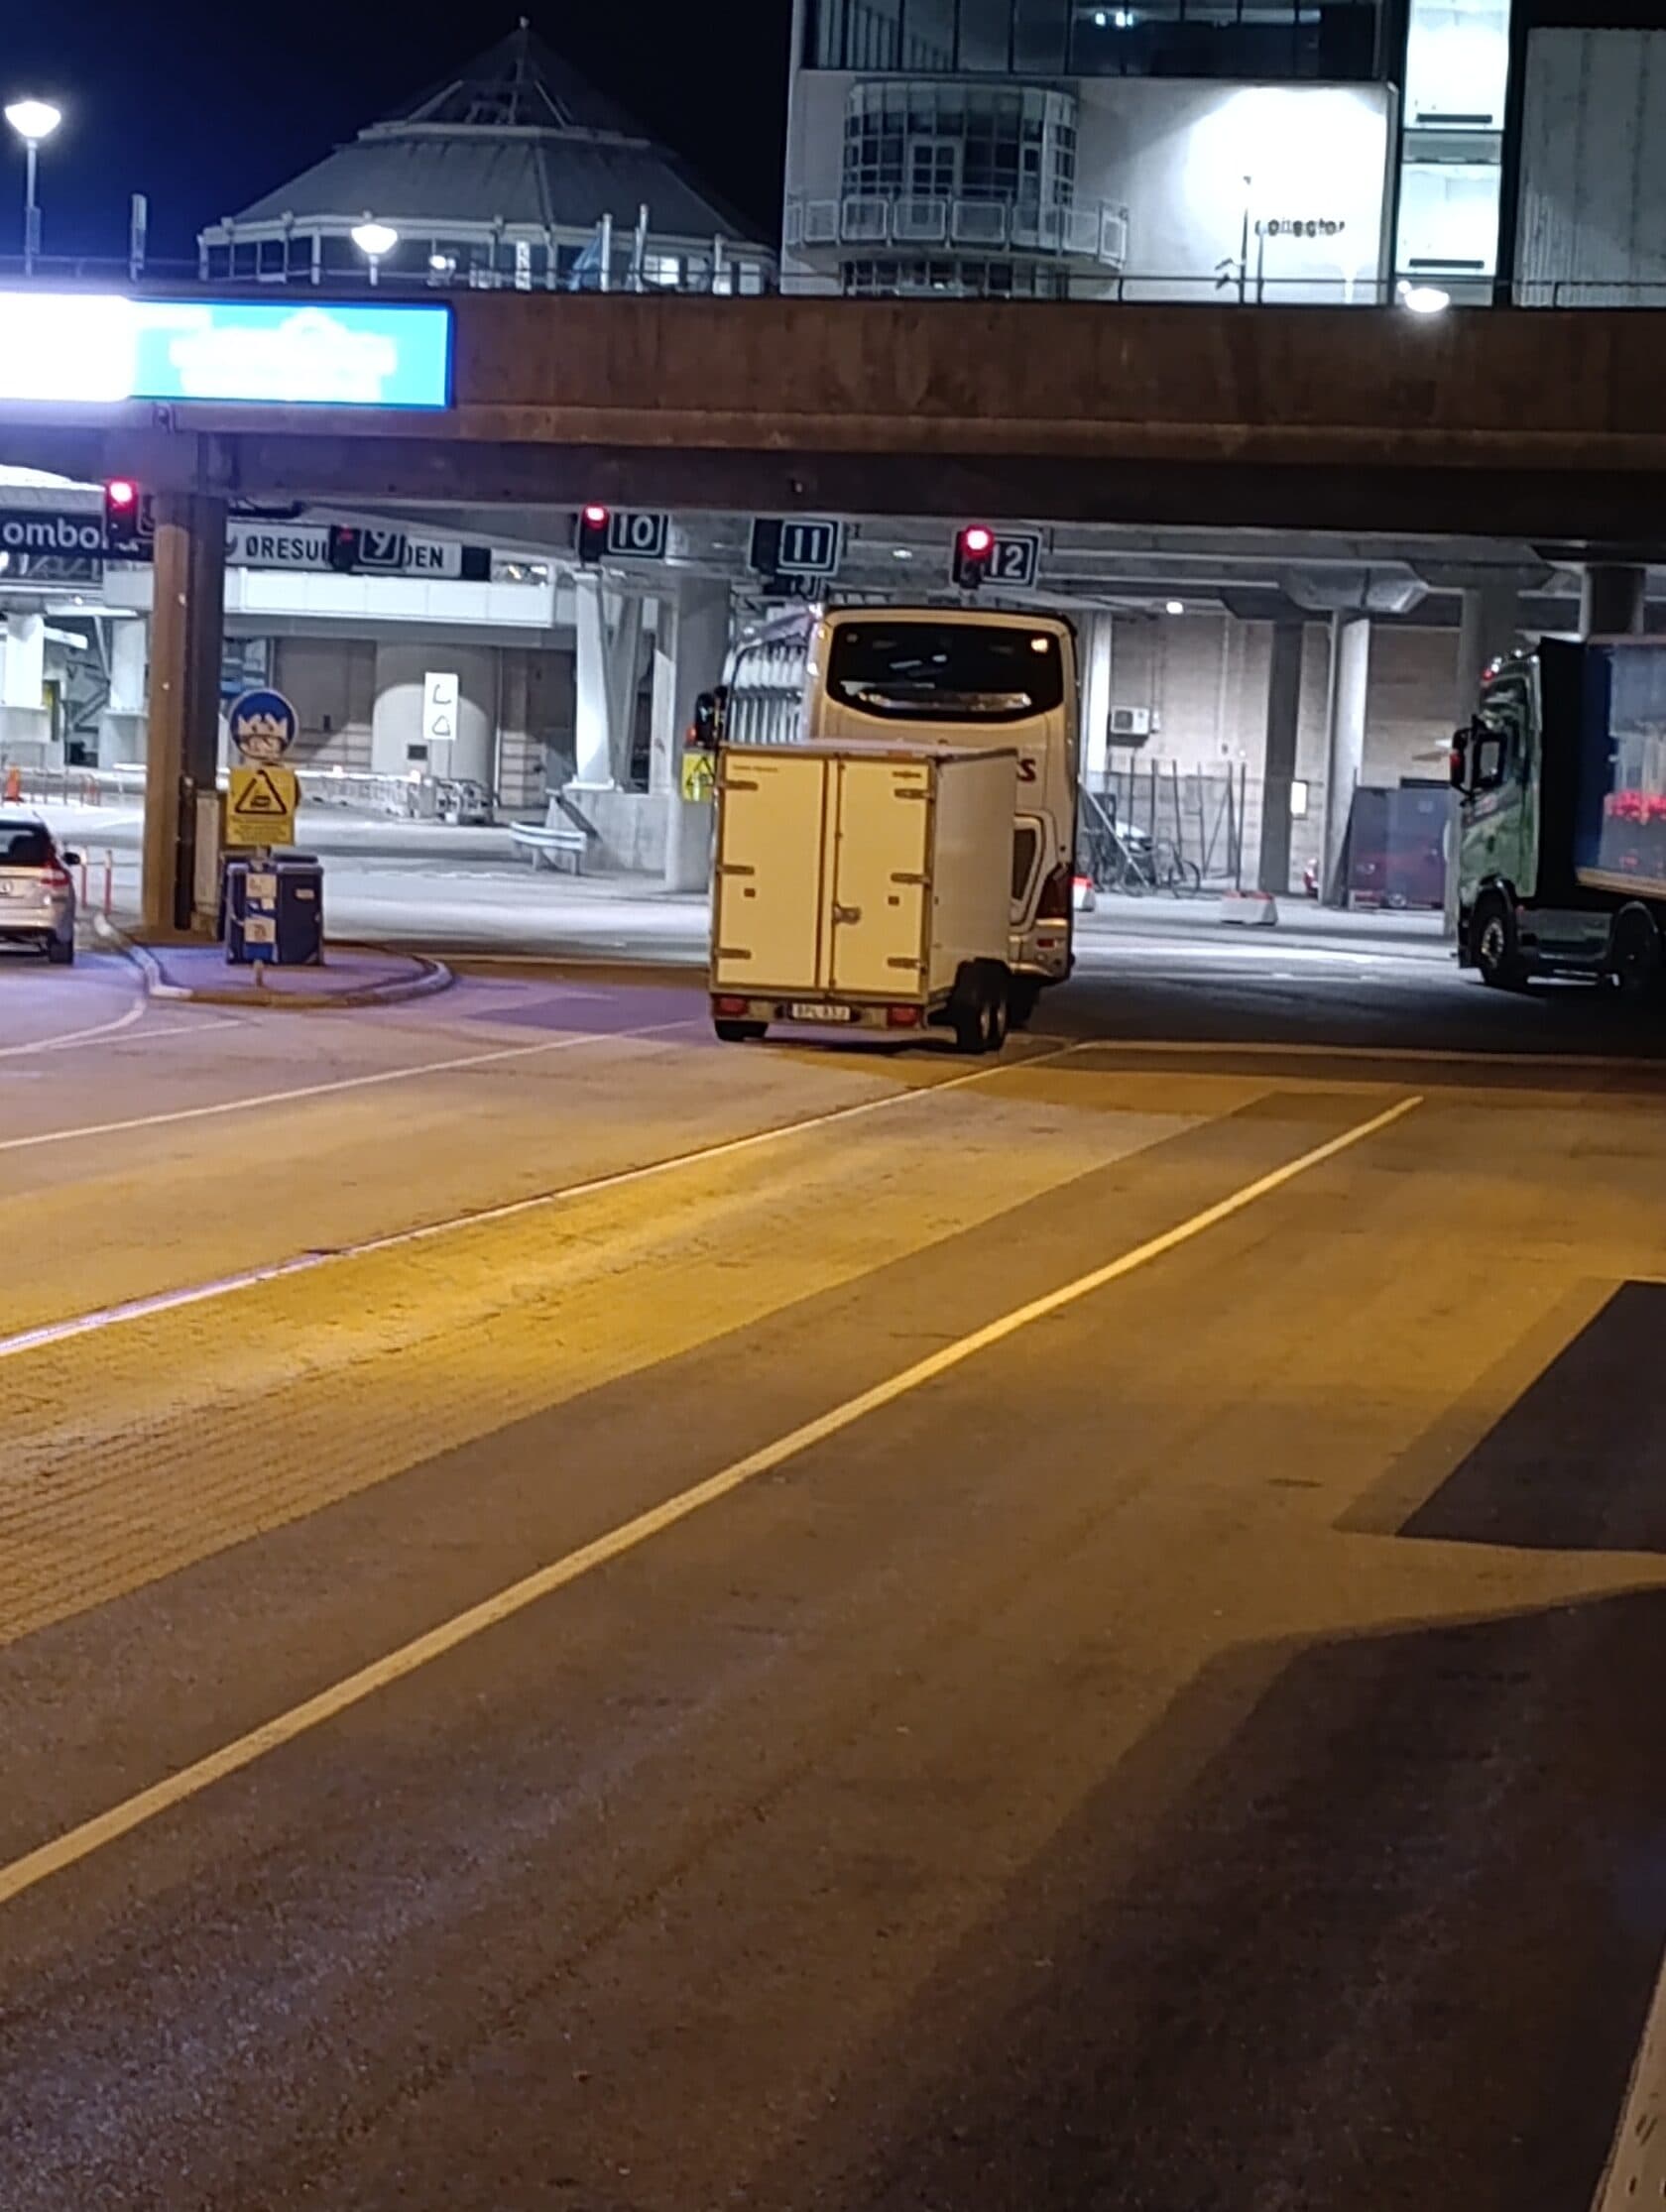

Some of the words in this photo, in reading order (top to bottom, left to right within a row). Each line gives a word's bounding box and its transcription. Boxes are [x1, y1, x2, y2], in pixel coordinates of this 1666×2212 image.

[618, 514, 654, 547] 10
[793, 527, 821, 561] 11
[991, 543, 1024, 577] 12
